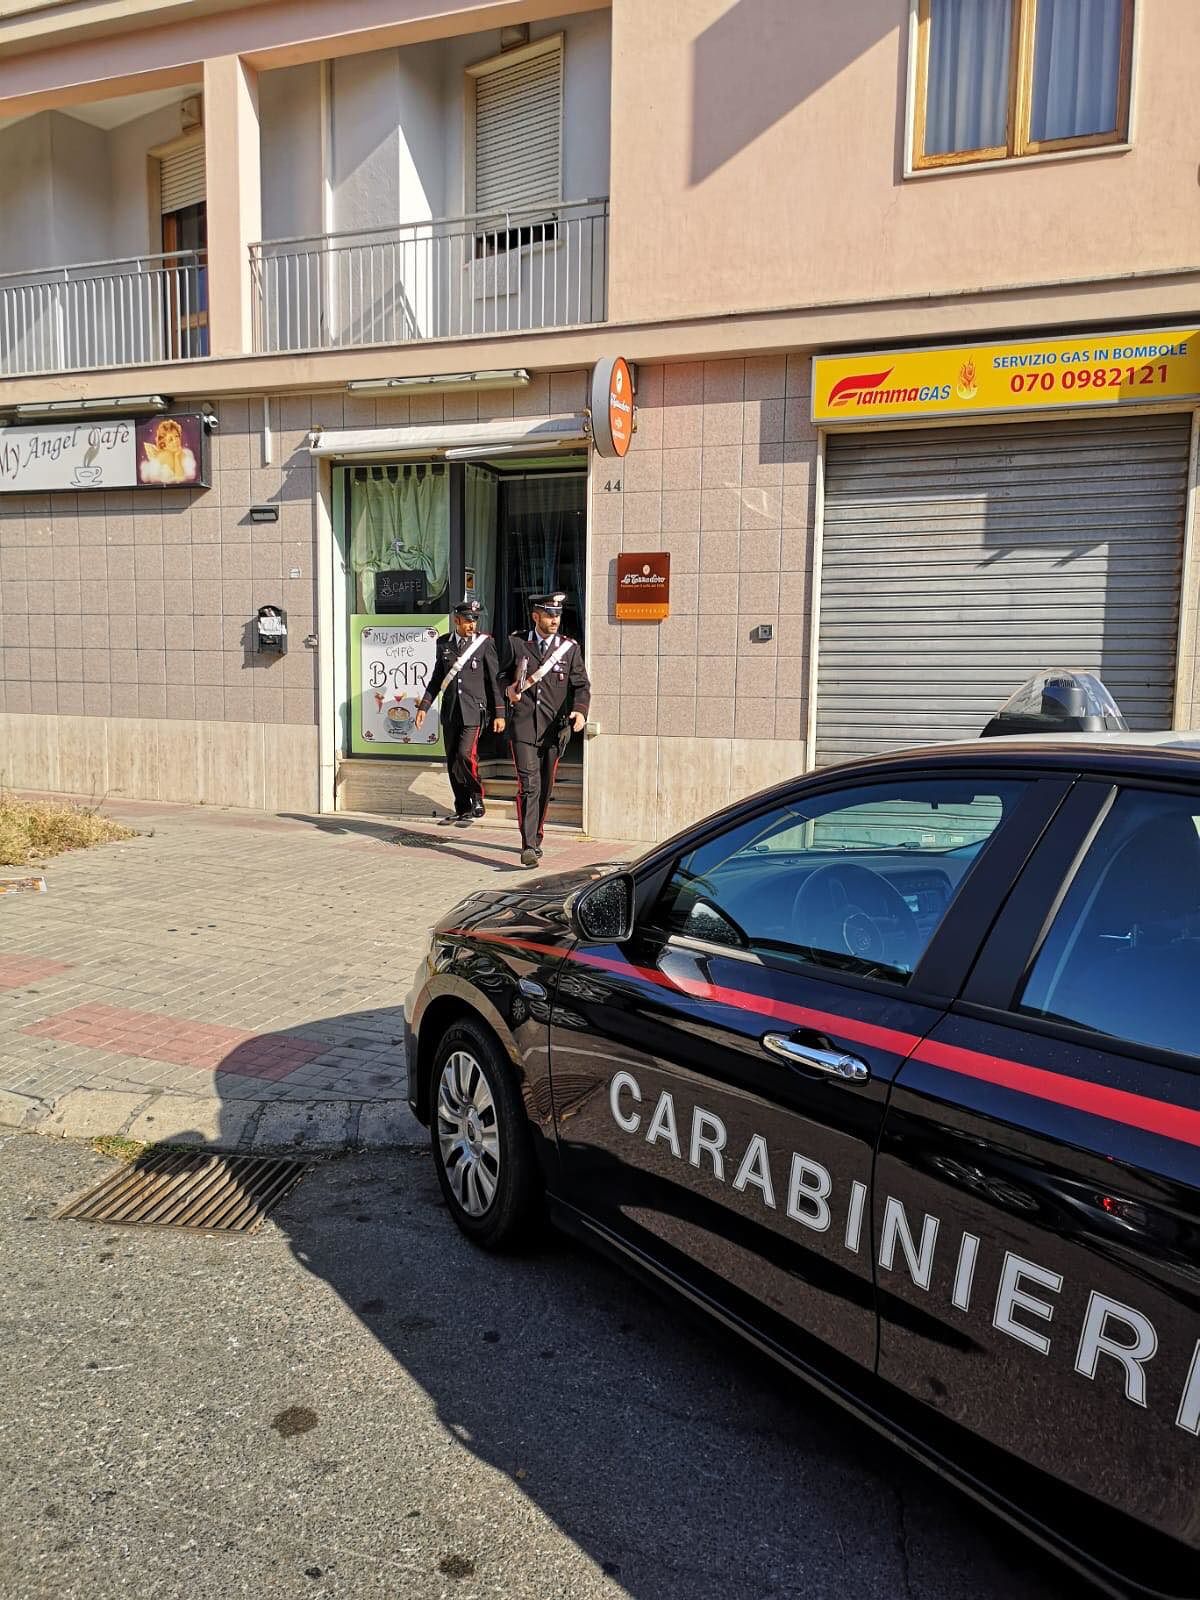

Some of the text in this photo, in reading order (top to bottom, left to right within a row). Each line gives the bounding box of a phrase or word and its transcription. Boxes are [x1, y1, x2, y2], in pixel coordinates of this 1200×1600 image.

[992, 343, 1188, 369] SERVIZIO GAS IN BOMBOLE
[1010, 364, 1169, 393] 070 0982121
[23, 426, 82, 467] Angel
[604, 479, 622, 492] 44
[390, 632, 428, 645] ANGEL
[369, 660, 428, 690] BAR
